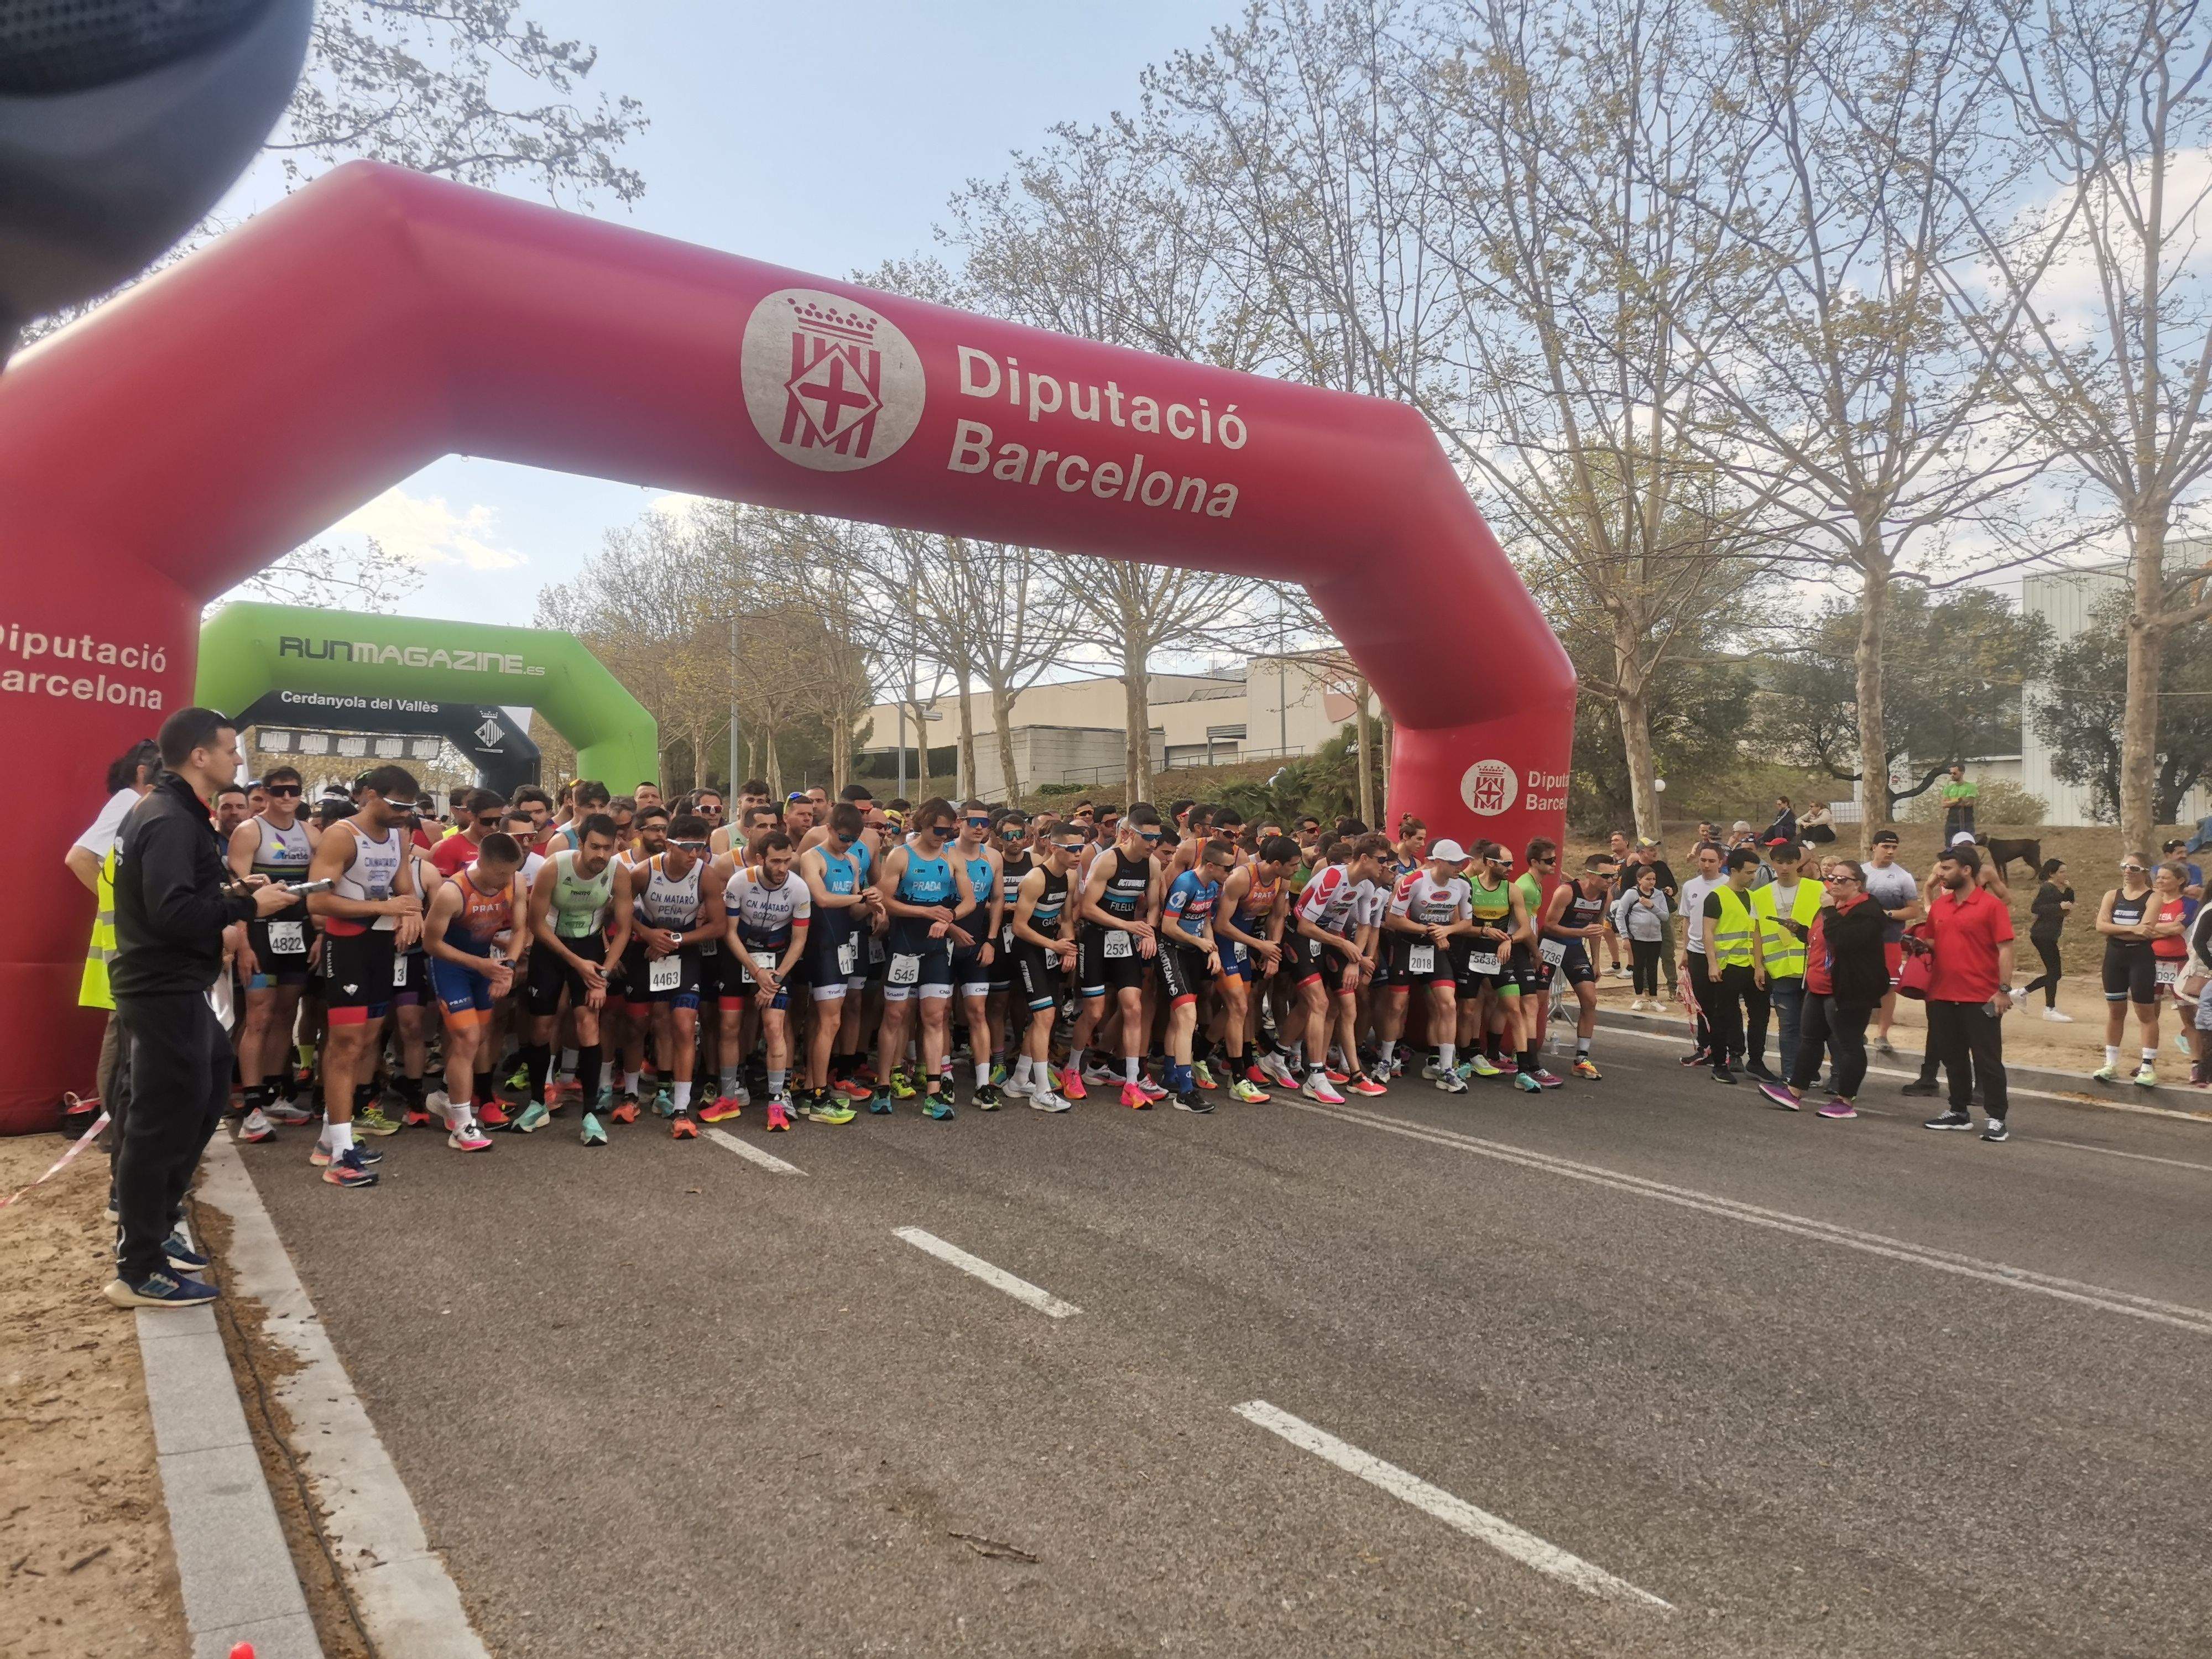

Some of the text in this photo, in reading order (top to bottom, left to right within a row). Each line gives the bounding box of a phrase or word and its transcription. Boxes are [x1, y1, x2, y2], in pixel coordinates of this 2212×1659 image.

[957, 345, 1247, 450] Diputació
[947, 419, 1239, 518] Barcelona
[0, 623, 166, 673] iputació
[0, 670, 163, 710] arcelona
[281, 691, 439, 713] Cerdanyola del Vallès
[664, 893, 695, 905] MATARÓ
[472, 903, 500, 913] PRAT
[658, 905, 682, 915] PEÑA
[272, 937, 303, 951] 4822
[1106, 943, 1129, 956] 2531
[1411, 957, 1432, 969] 2018
[653, 971, 679, 987] 4463
[894, 968, 915, 982] 545
[449, 998, 467, 1006] PRAT
